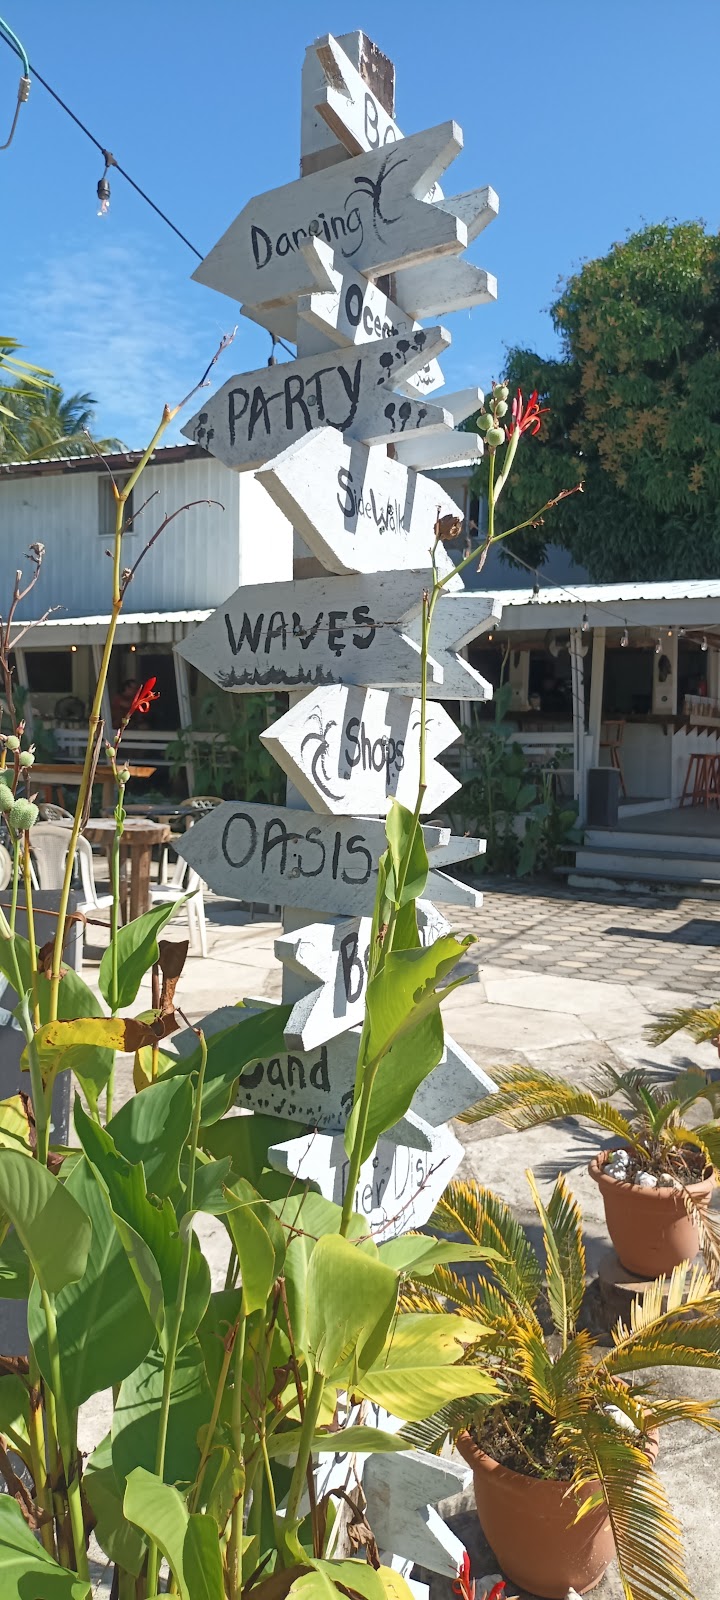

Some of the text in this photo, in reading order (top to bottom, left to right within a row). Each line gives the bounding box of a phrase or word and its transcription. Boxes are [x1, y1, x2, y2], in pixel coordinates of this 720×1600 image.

[228, 359, 362, 446] PARTY
[225, 606, 376, 656] WAVES
[345, 717, 405, 785] Shops
[222, 813, 373, 884] OASIS
